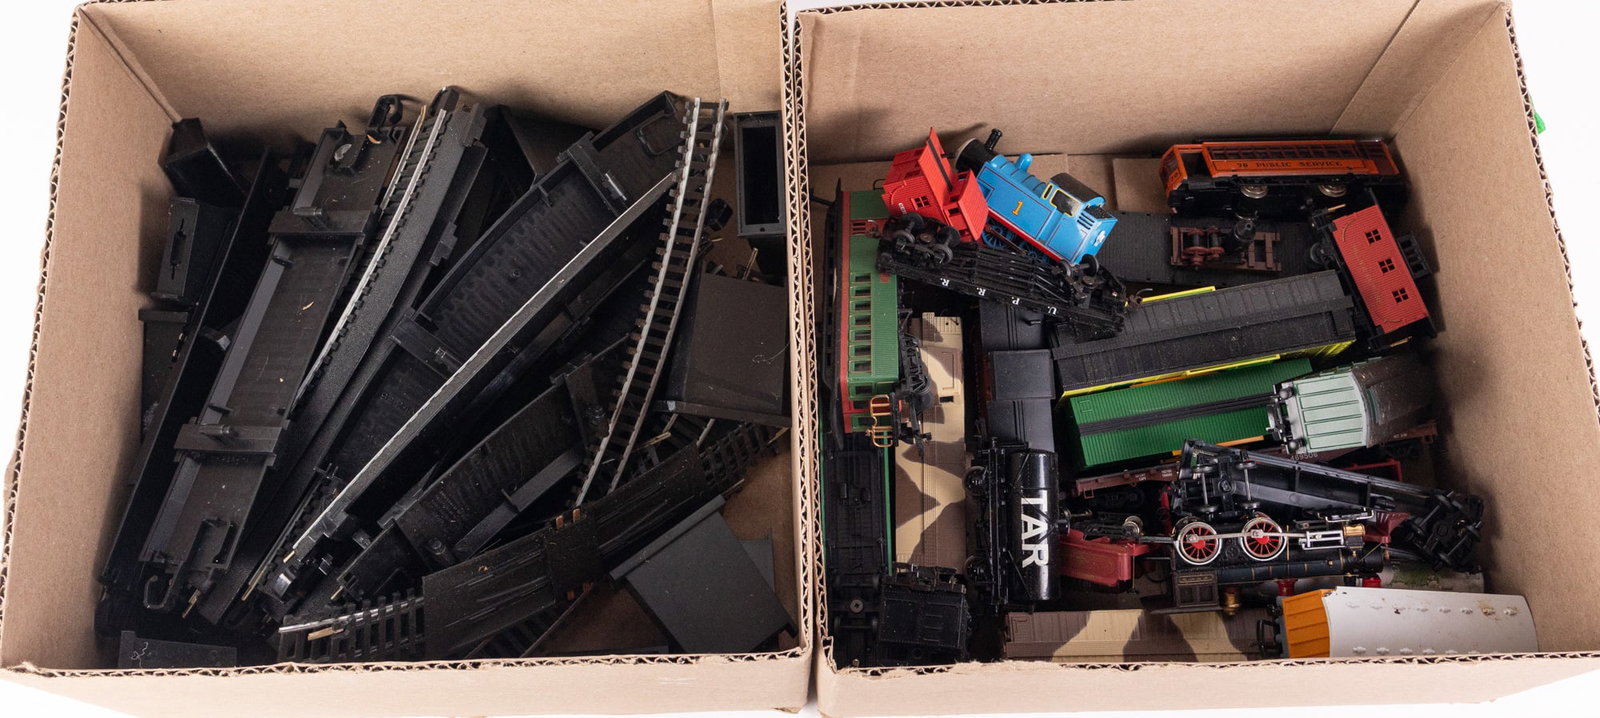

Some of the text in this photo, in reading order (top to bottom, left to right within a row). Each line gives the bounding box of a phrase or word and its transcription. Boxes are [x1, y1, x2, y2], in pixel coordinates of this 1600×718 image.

[1011, 200, 1023, 216] 1
[940, 277, 1057, 315] U. P. R. R.
[1020, 489, 1049, 568] TAR
